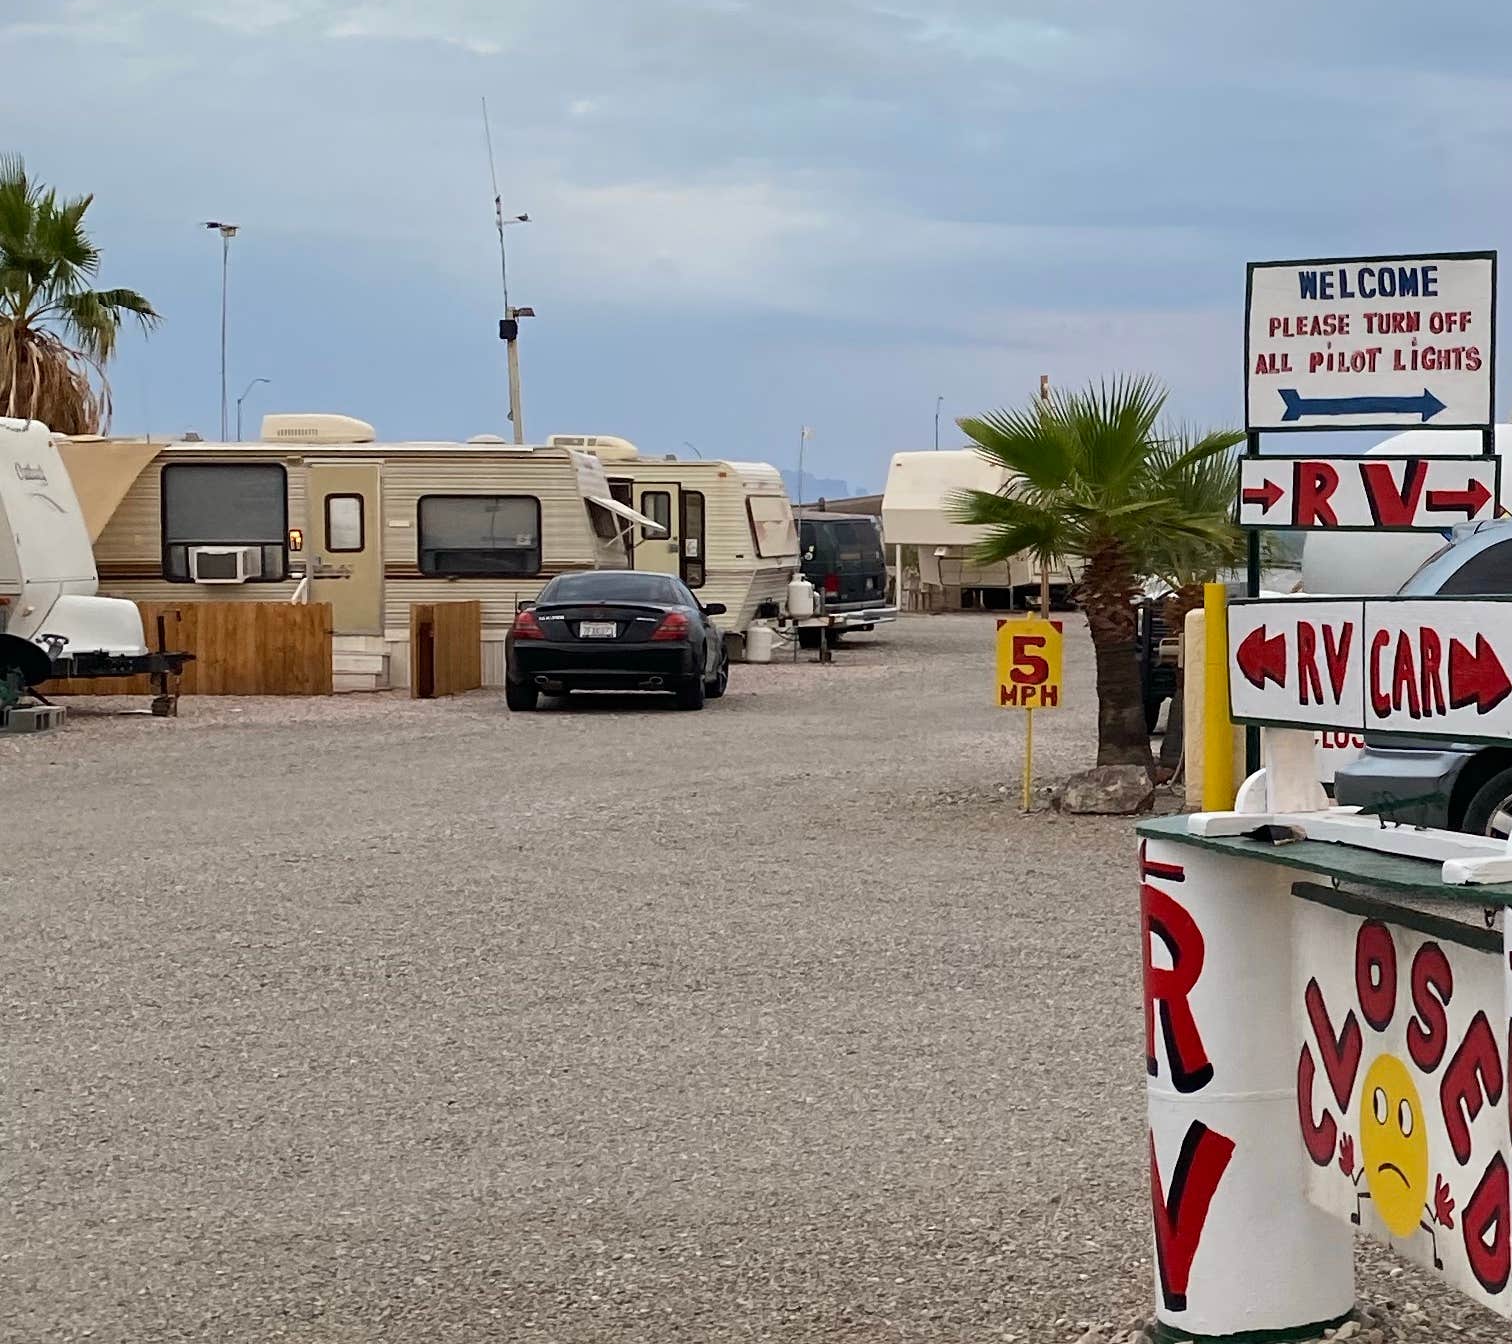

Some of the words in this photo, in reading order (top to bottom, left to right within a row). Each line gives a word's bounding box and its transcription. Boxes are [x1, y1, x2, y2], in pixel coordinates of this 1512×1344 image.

[1299, 266, 1438, 300] WELCOME
[1269, 314, 1350, 338] PLEASE
[1363, 311, 1420, 334] TURN
[1429, 311, 1472, 334] OFF
[1255, 353, 1293, 375] ALL
[1309, 342, 1382, 373] PILOT
[1393, 337, 1482, 371] LIGHTS
[1292, 459, 1428, 527] RV
[1010, 636, 1049, 685] 5
[1297, 621, 1353, 706] RV
[1370, 626, 1447, 720] CAR
[1001, 684, 1058, 707] MPH
